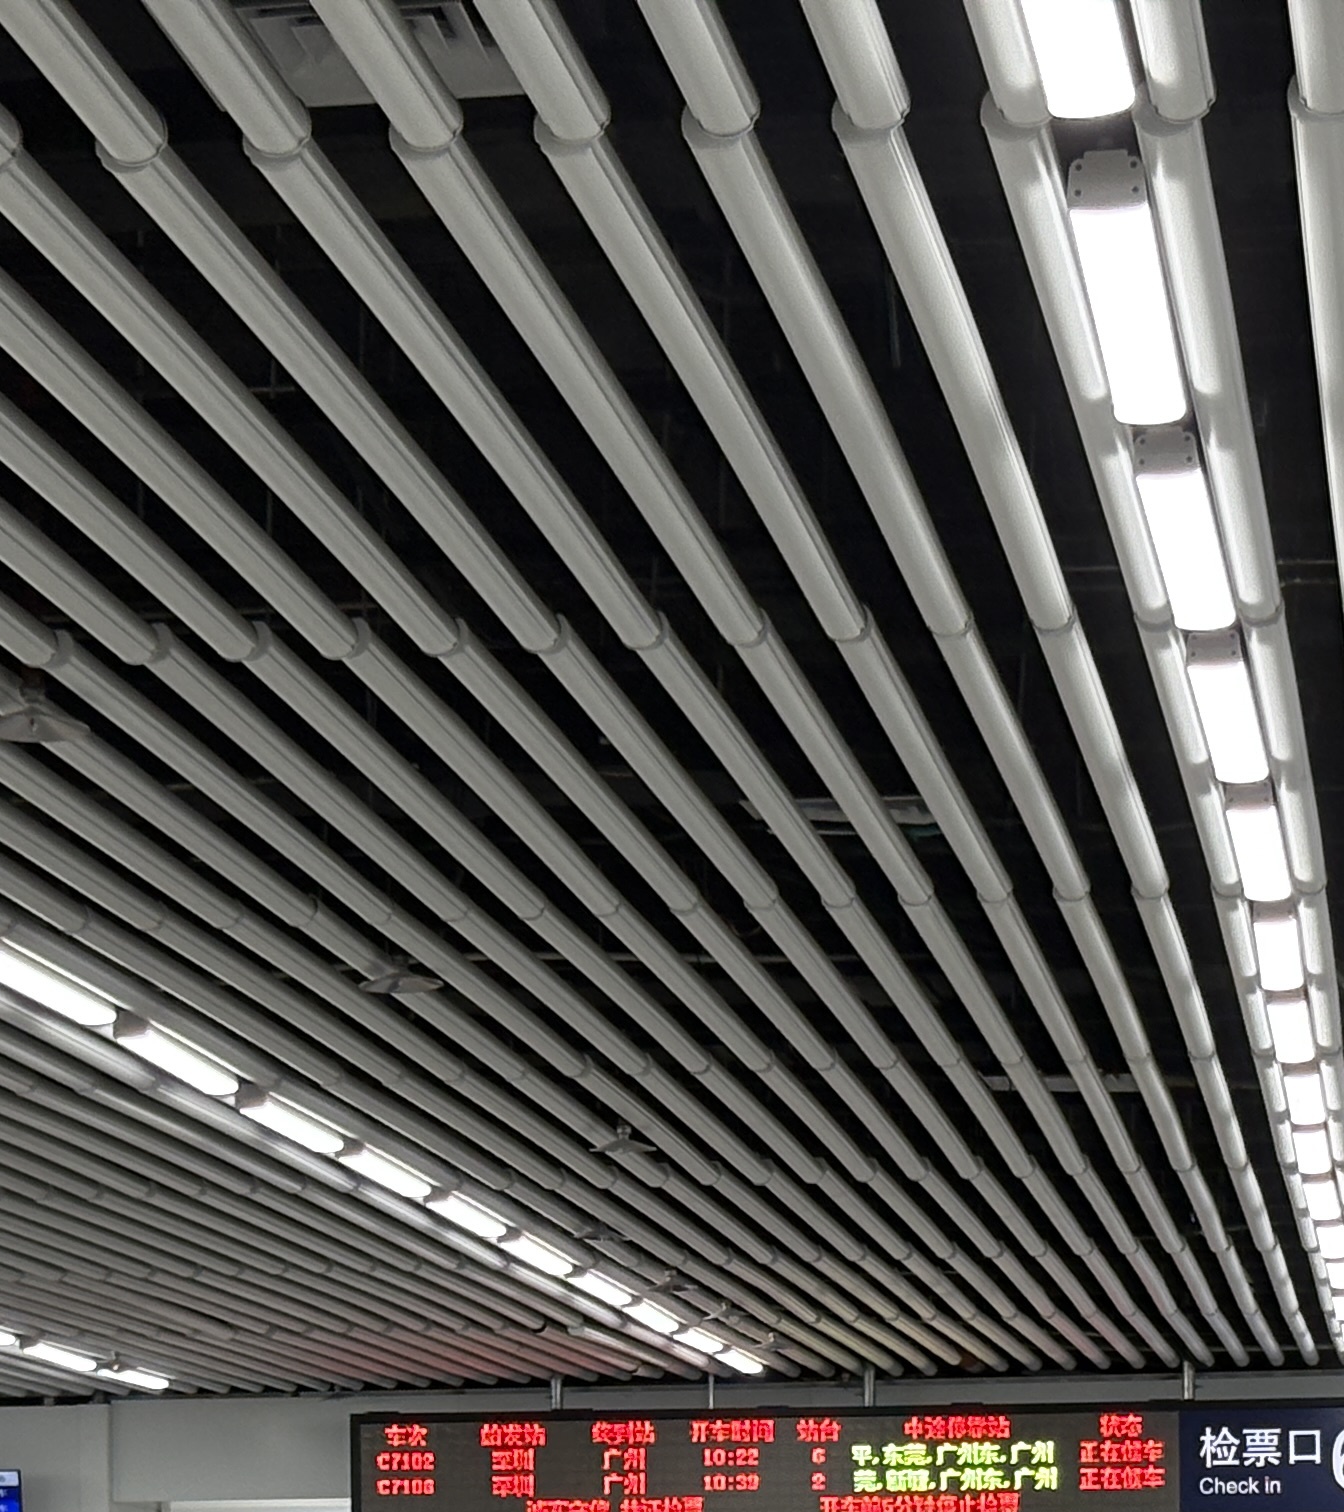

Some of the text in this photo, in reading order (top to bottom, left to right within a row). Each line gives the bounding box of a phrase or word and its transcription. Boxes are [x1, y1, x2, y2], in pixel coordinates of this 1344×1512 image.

[384, 1413, 1143, 1446] 车次 始发站 终到站 开车时间 站台 中途停靠站 状态
[377, 1453, 435, 1470] C7102
[492, 1448, 534, 1471] 深圳
[603, 1447, 646, 1470] 广州
[704, 1448, 759, 1466] 10:22
[1079, 1440, 1165, 1463] 正在候车
[1199, 1427, 1322, 1469] 检票口
[377, 1479, 435, 1495] C7106
[492, 1473, 534, 1497] 深圳
[603, 1472, 646, 1495] 广州
[1079, 1467, 1165, 1490] 正在候车
[1199, 1476, 1282, 1495] Check in
